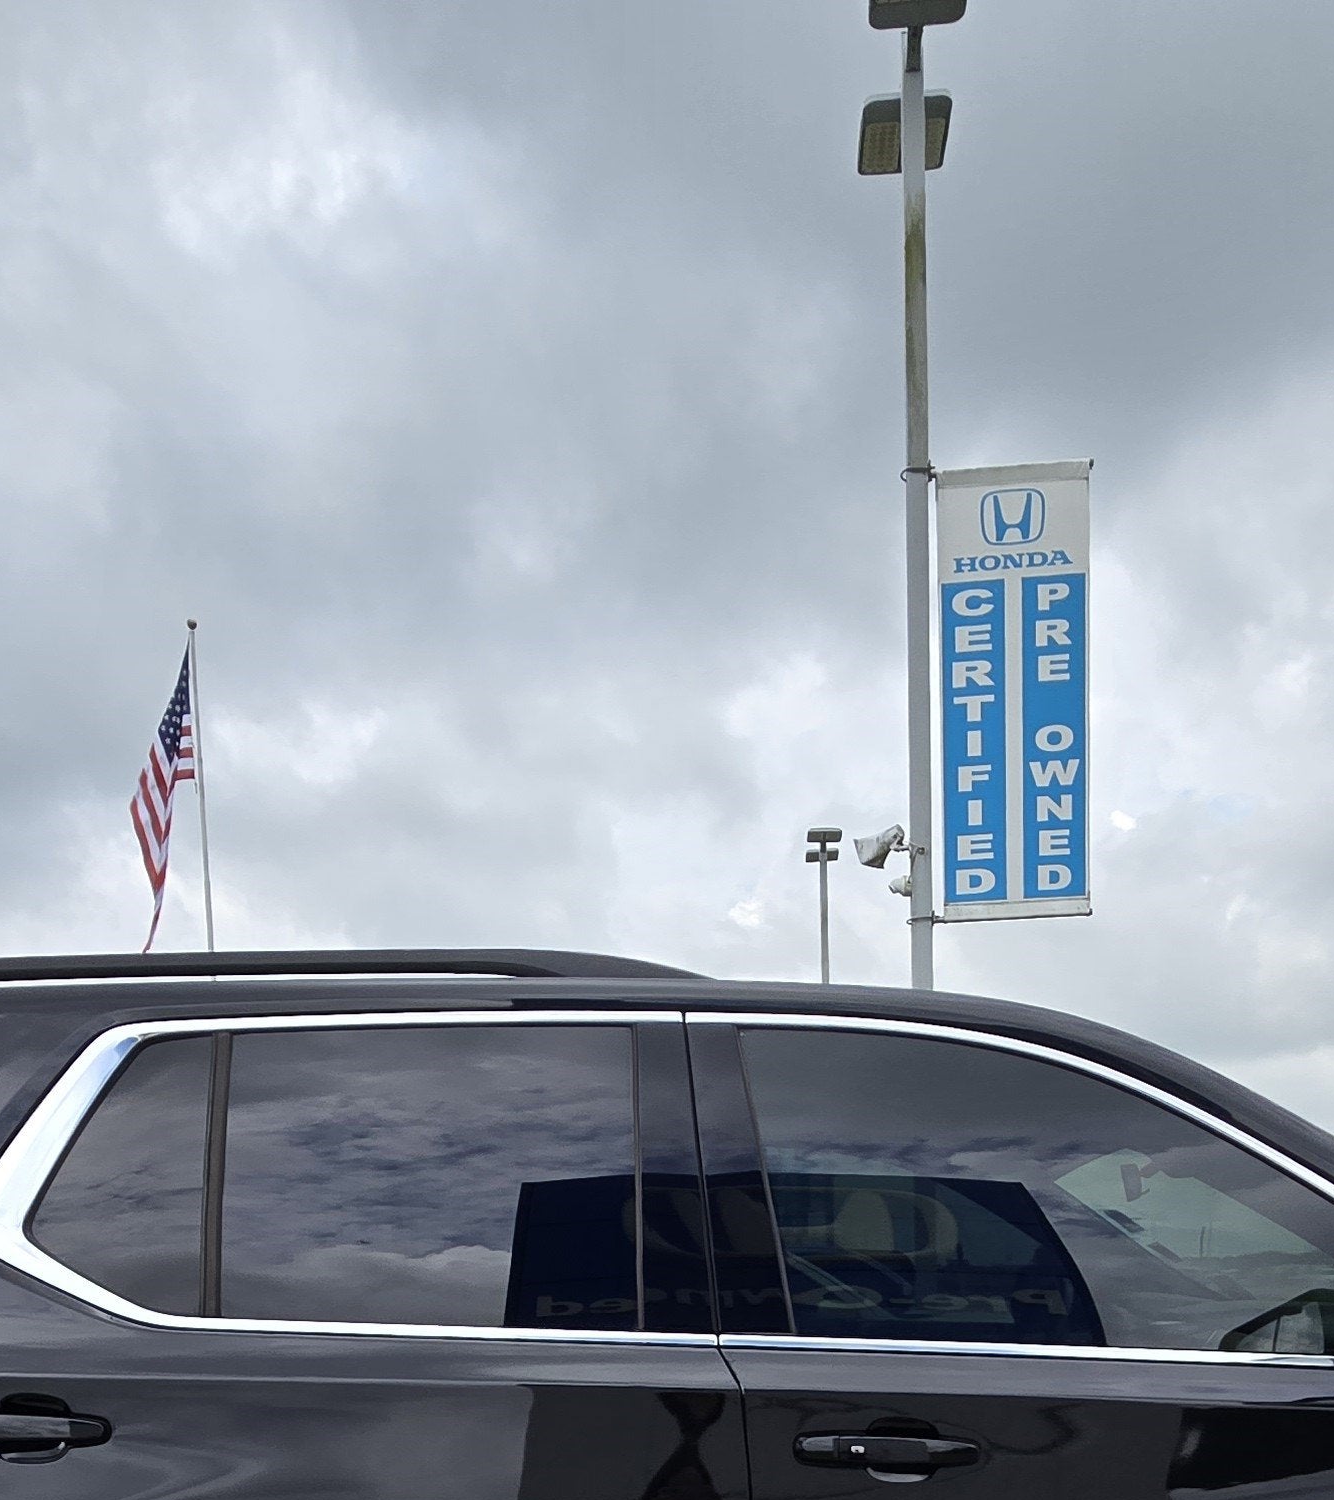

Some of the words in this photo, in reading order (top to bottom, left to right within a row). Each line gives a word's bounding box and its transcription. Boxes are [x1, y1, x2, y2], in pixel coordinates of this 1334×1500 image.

[953, 549, 1073, 574] HONDA
[1035, 583, 1072, 682] PRE
[951, 588, 997, 895] CERTIFIED
[1029, 724, 1080, 892] OWNED
